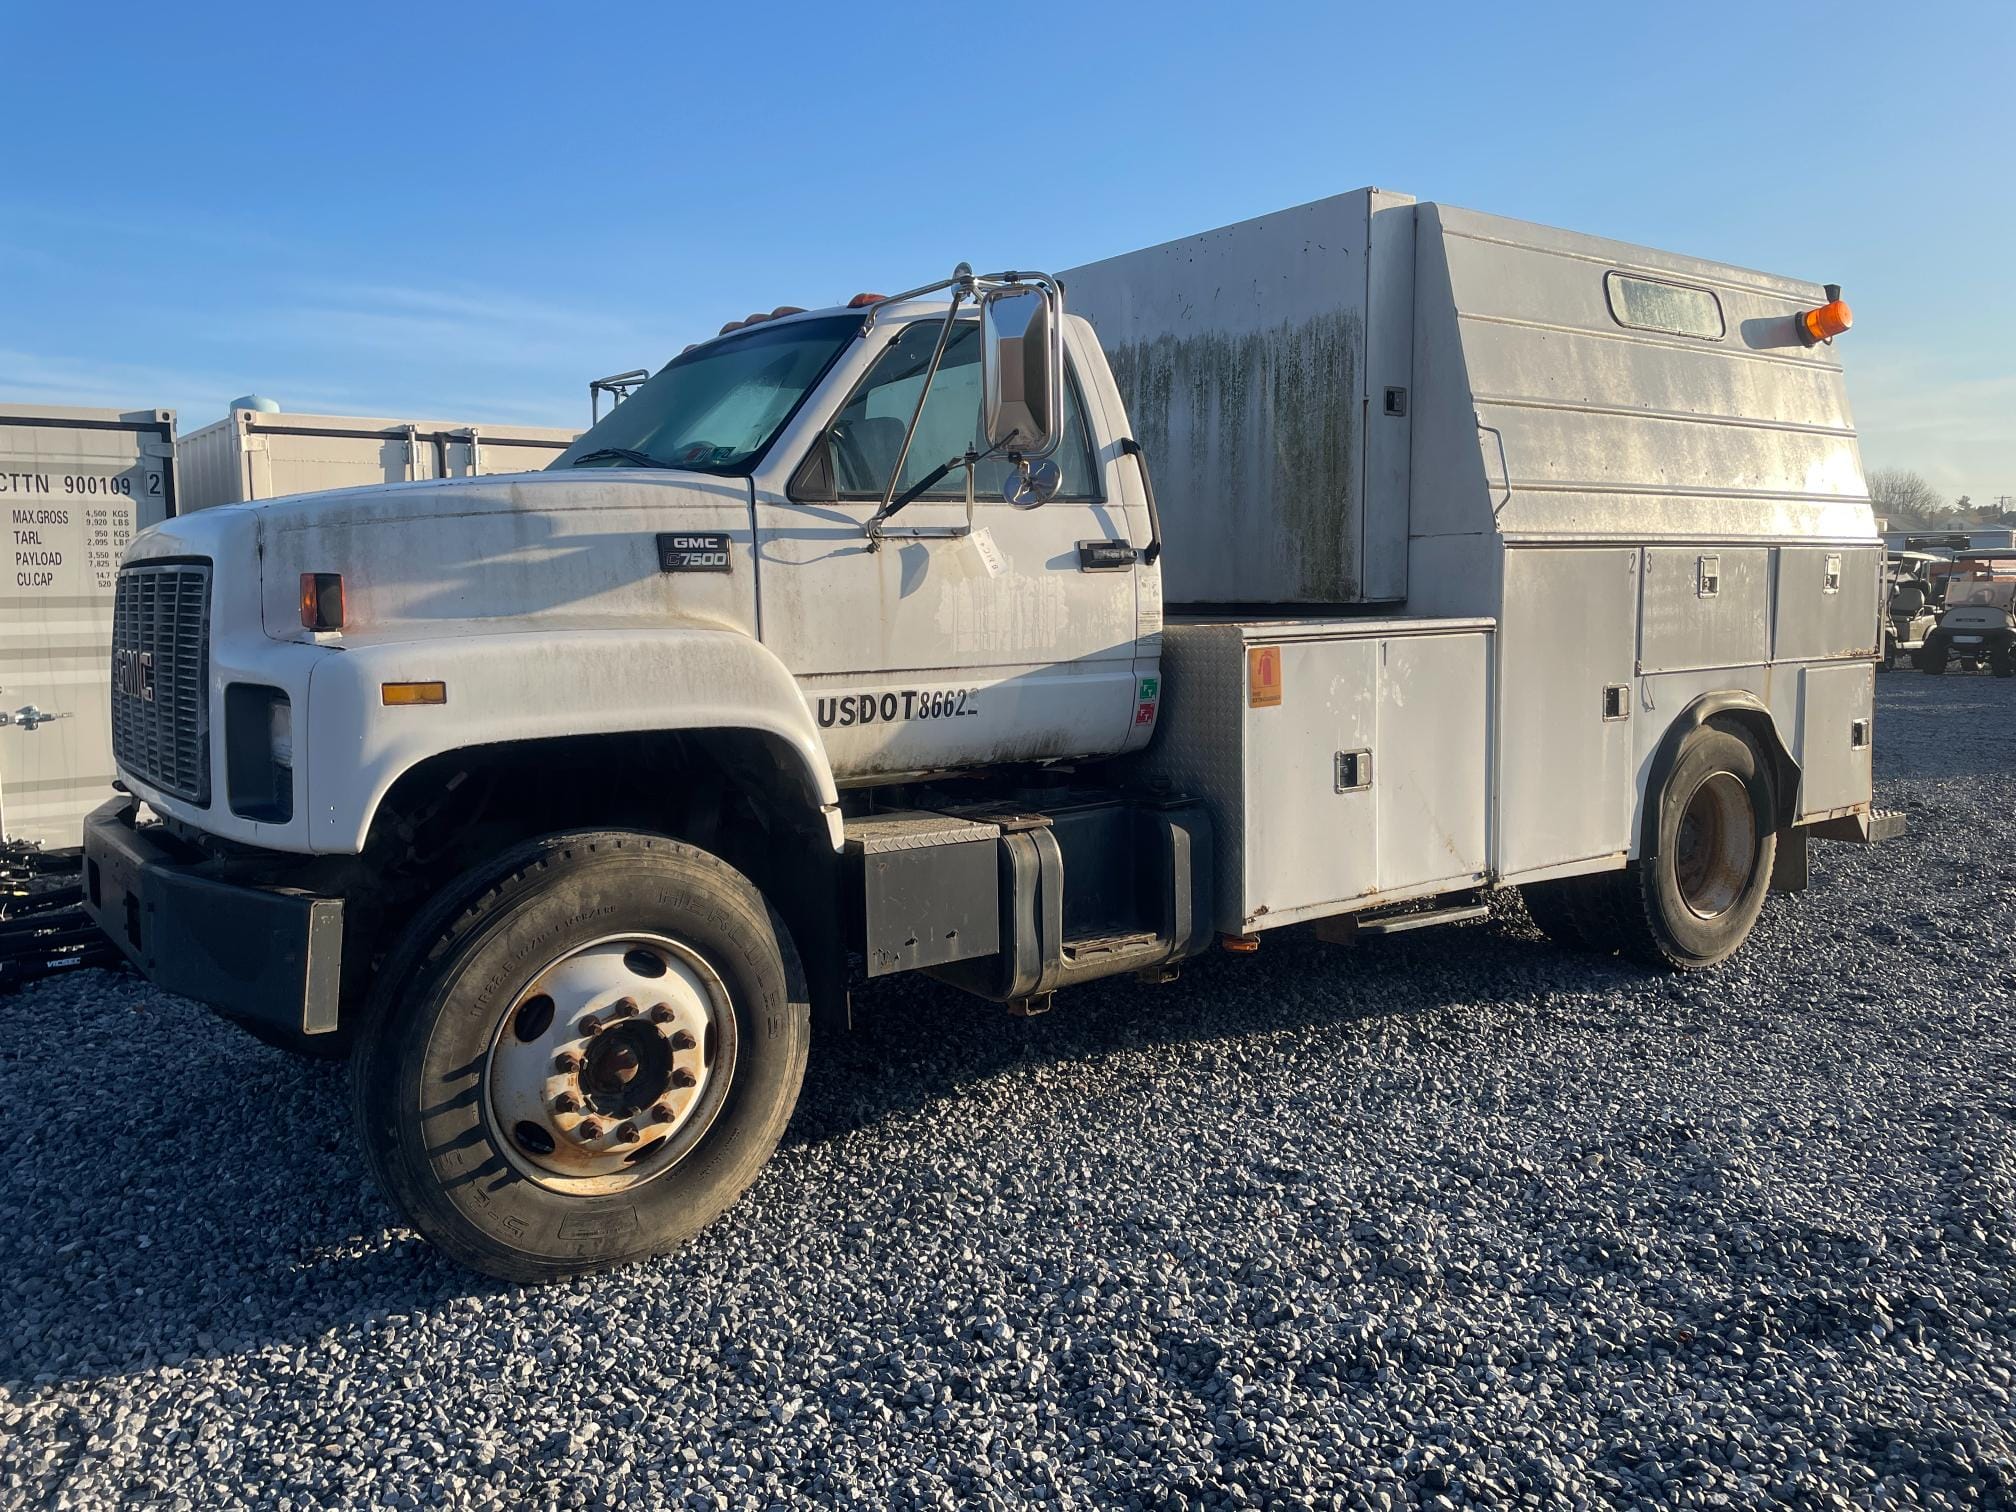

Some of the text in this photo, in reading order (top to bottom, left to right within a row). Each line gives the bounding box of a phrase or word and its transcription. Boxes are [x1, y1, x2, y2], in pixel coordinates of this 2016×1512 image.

[64, 475, 131, 496] 900109
[149, 473, 161, 495] 2
[12, 509, 69, 524] MAX.GROSS
[85, 510, 129, 518] 4,500 KGS
[13, 530, 42, 545] TARL
[94, 530, 130, 538] 950 KGS
[673, 538, 718, 549] GMC
[15, 551, 62, 566] PAYLOAD
[1629, 553, 1636, 574] 2
[1646, 553, 1652, 574] 3
[17, 572, 53, 586] CU.CAP
[98, 580, 112, 588] 520
[1381, 641, 1387, 666] 1
[117, 648, 153, 701] GMC
